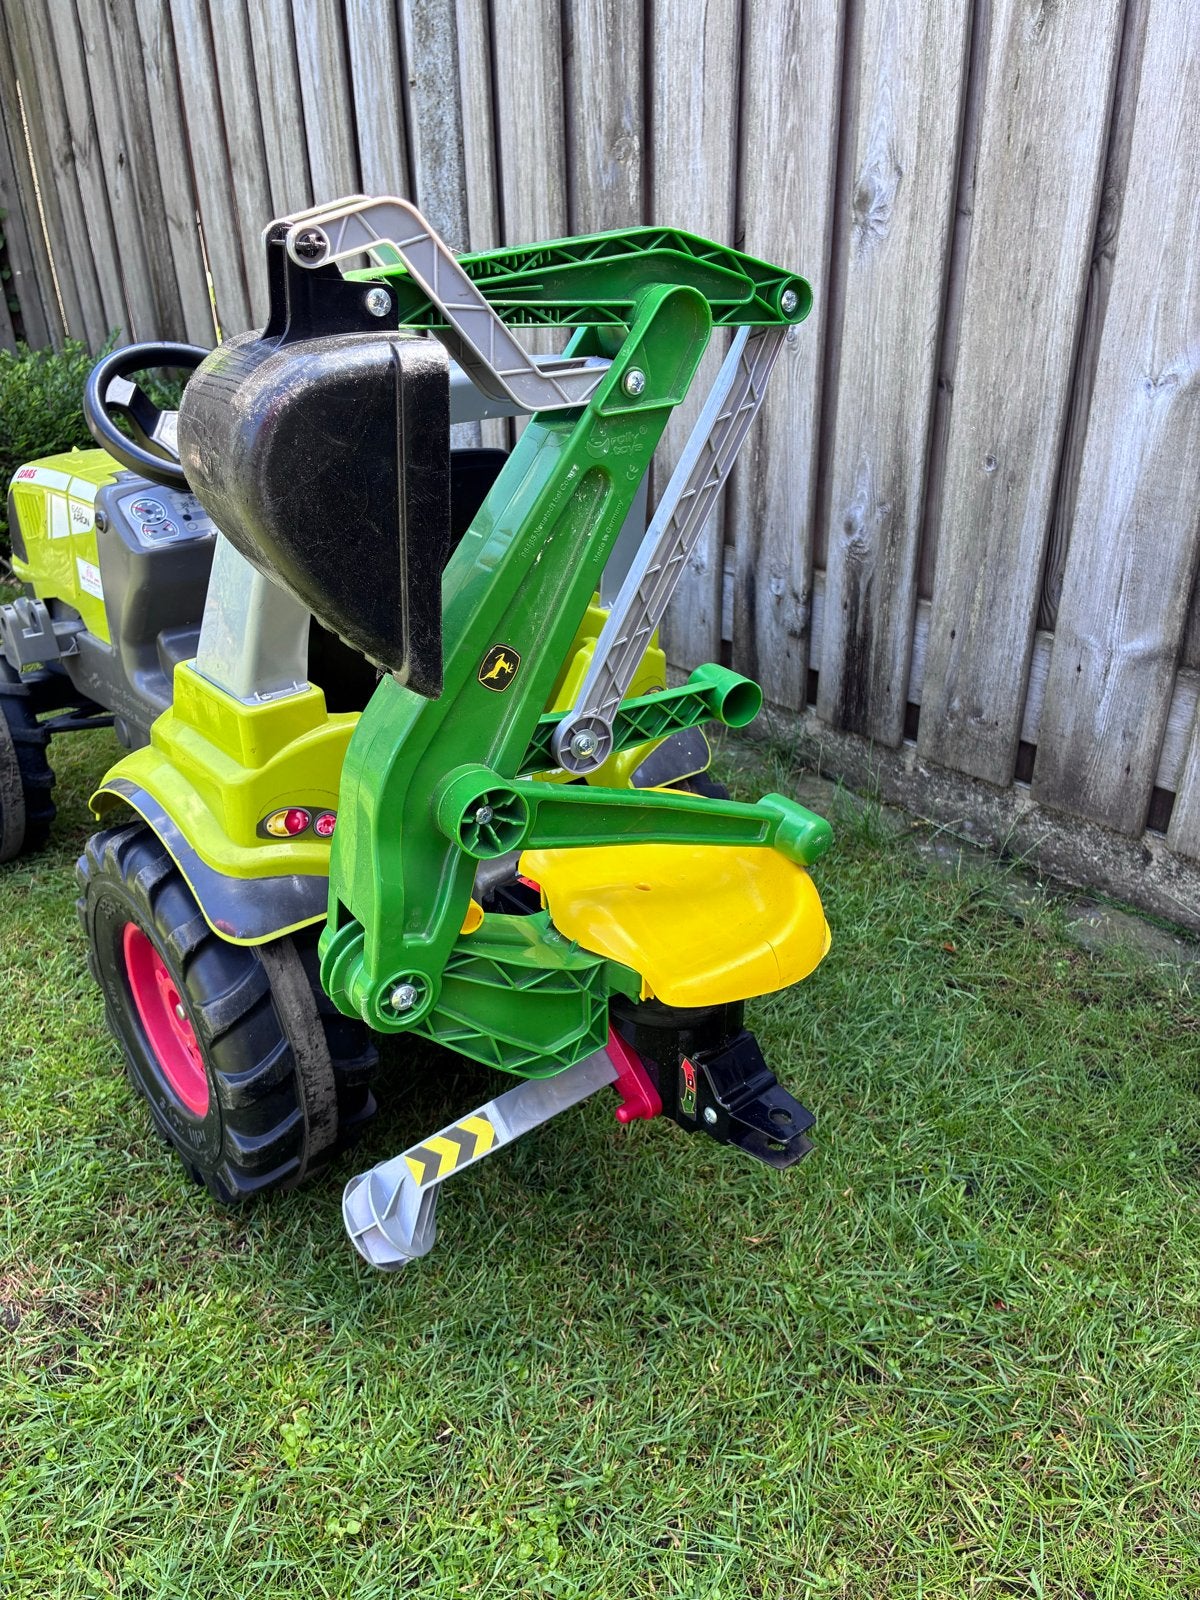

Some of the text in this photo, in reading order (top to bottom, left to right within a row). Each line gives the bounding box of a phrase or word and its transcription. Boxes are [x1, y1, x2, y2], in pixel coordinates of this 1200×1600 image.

[610, 431, 640, 446] rolly
[612, 443, 644, 456] toys
[17, 469, 38, 479] CLAAS
[592, 541, 605, 564] Made
[606, 499, 624, 534] Germany
